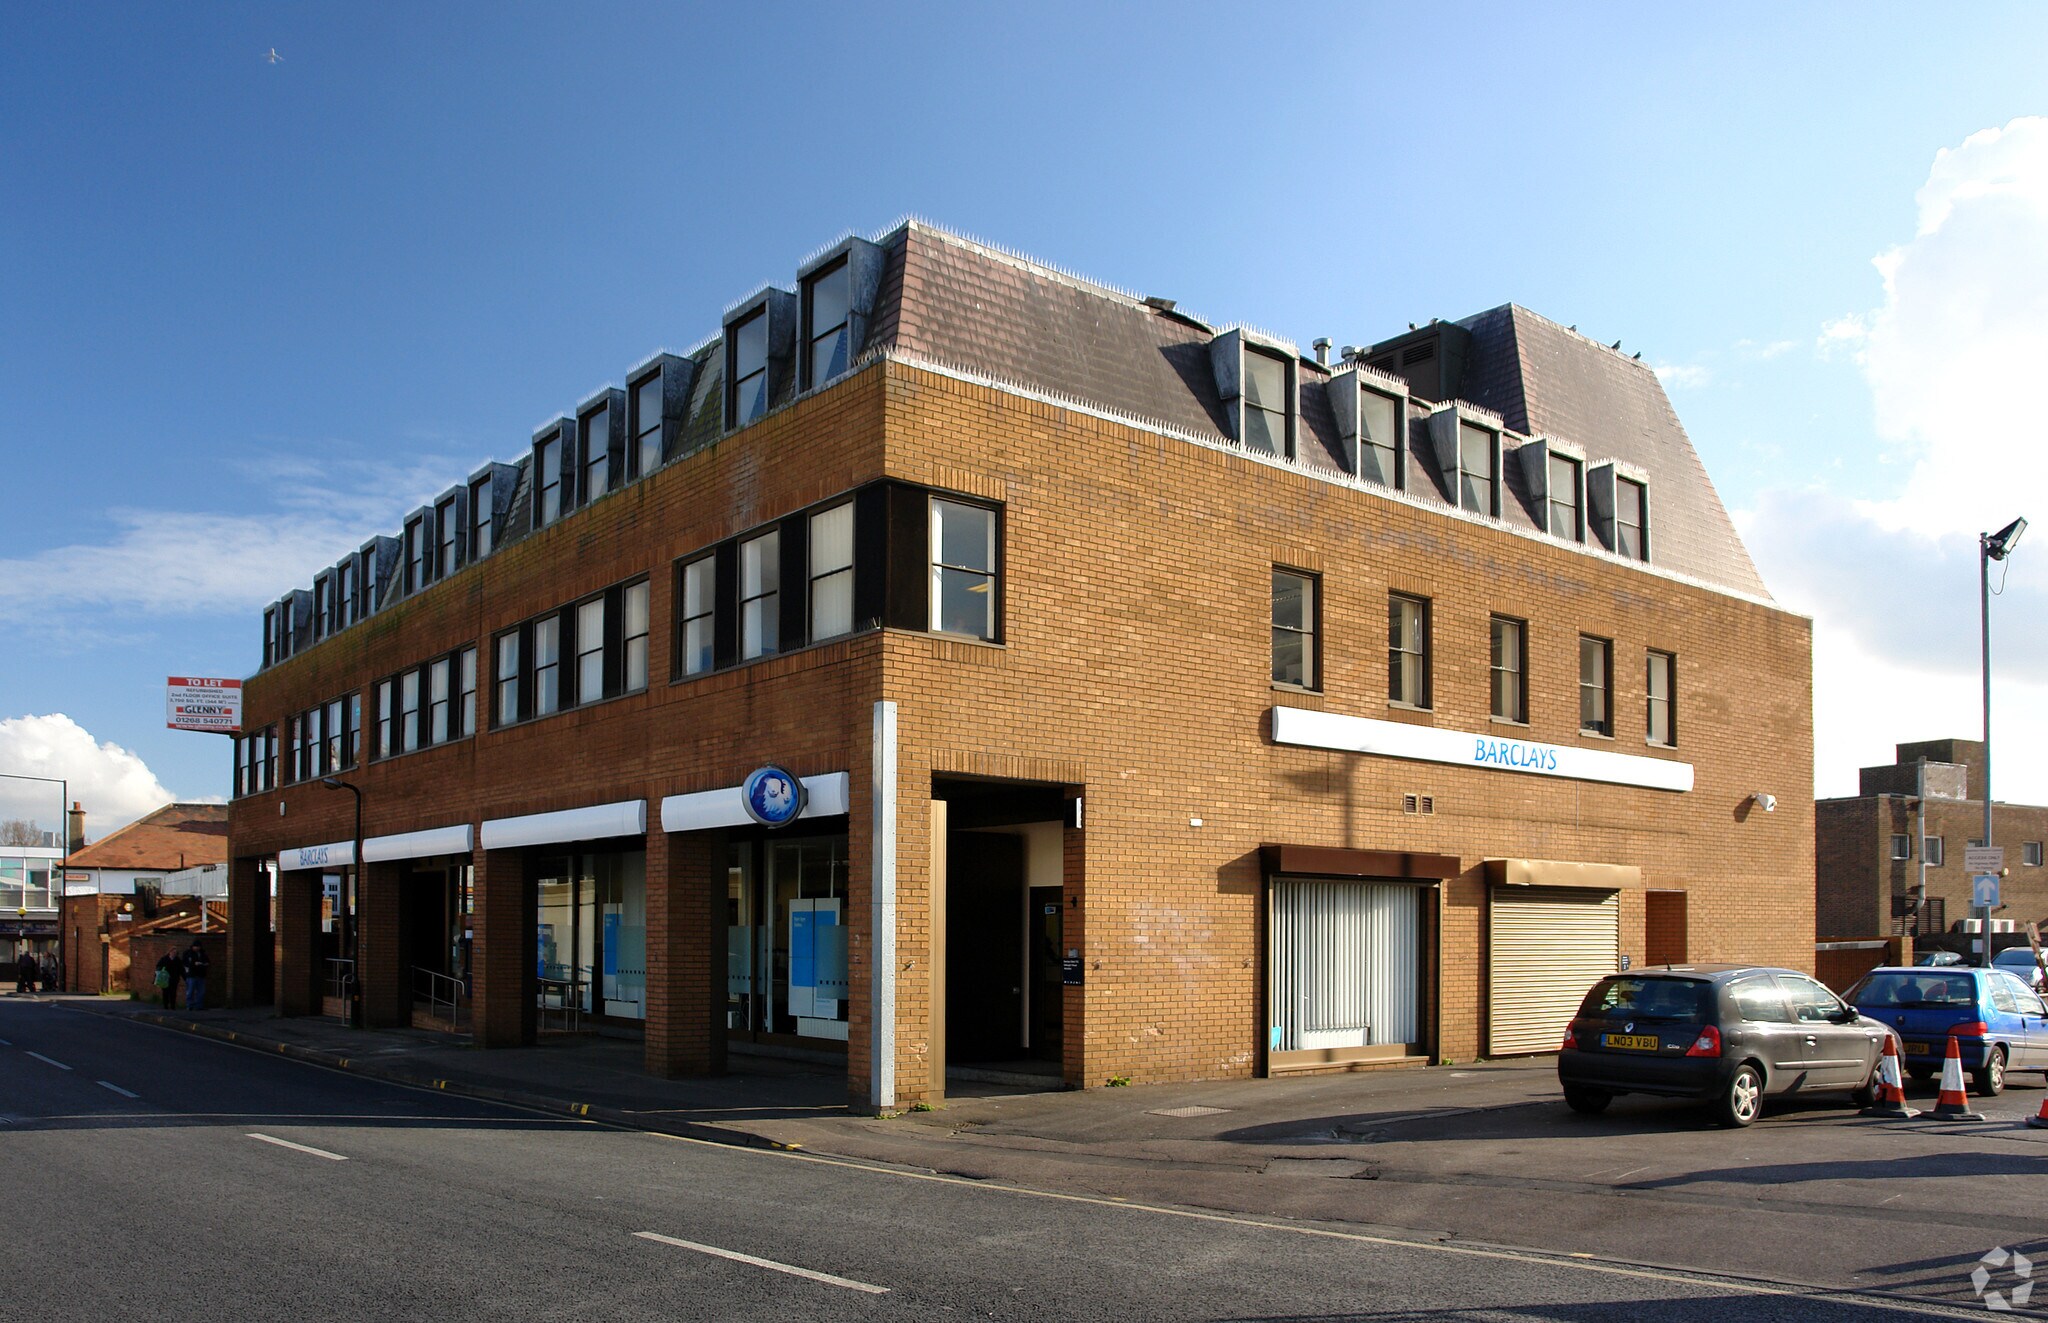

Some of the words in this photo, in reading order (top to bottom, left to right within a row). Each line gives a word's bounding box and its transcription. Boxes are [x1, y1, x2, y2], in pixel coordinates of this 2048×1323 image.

[187, 678, 200, 686] TO
[204, 679, 223, 687] LET
[185, 705, 223, 714] GLENNY
[1474, 739, 1557, 771] BARCLAYS
[300, 847, 329, 866] BARCLAYS
[1607, 1036, 1633, 1047] LN03
[1636, 1037, 1657, 1048] VBU
